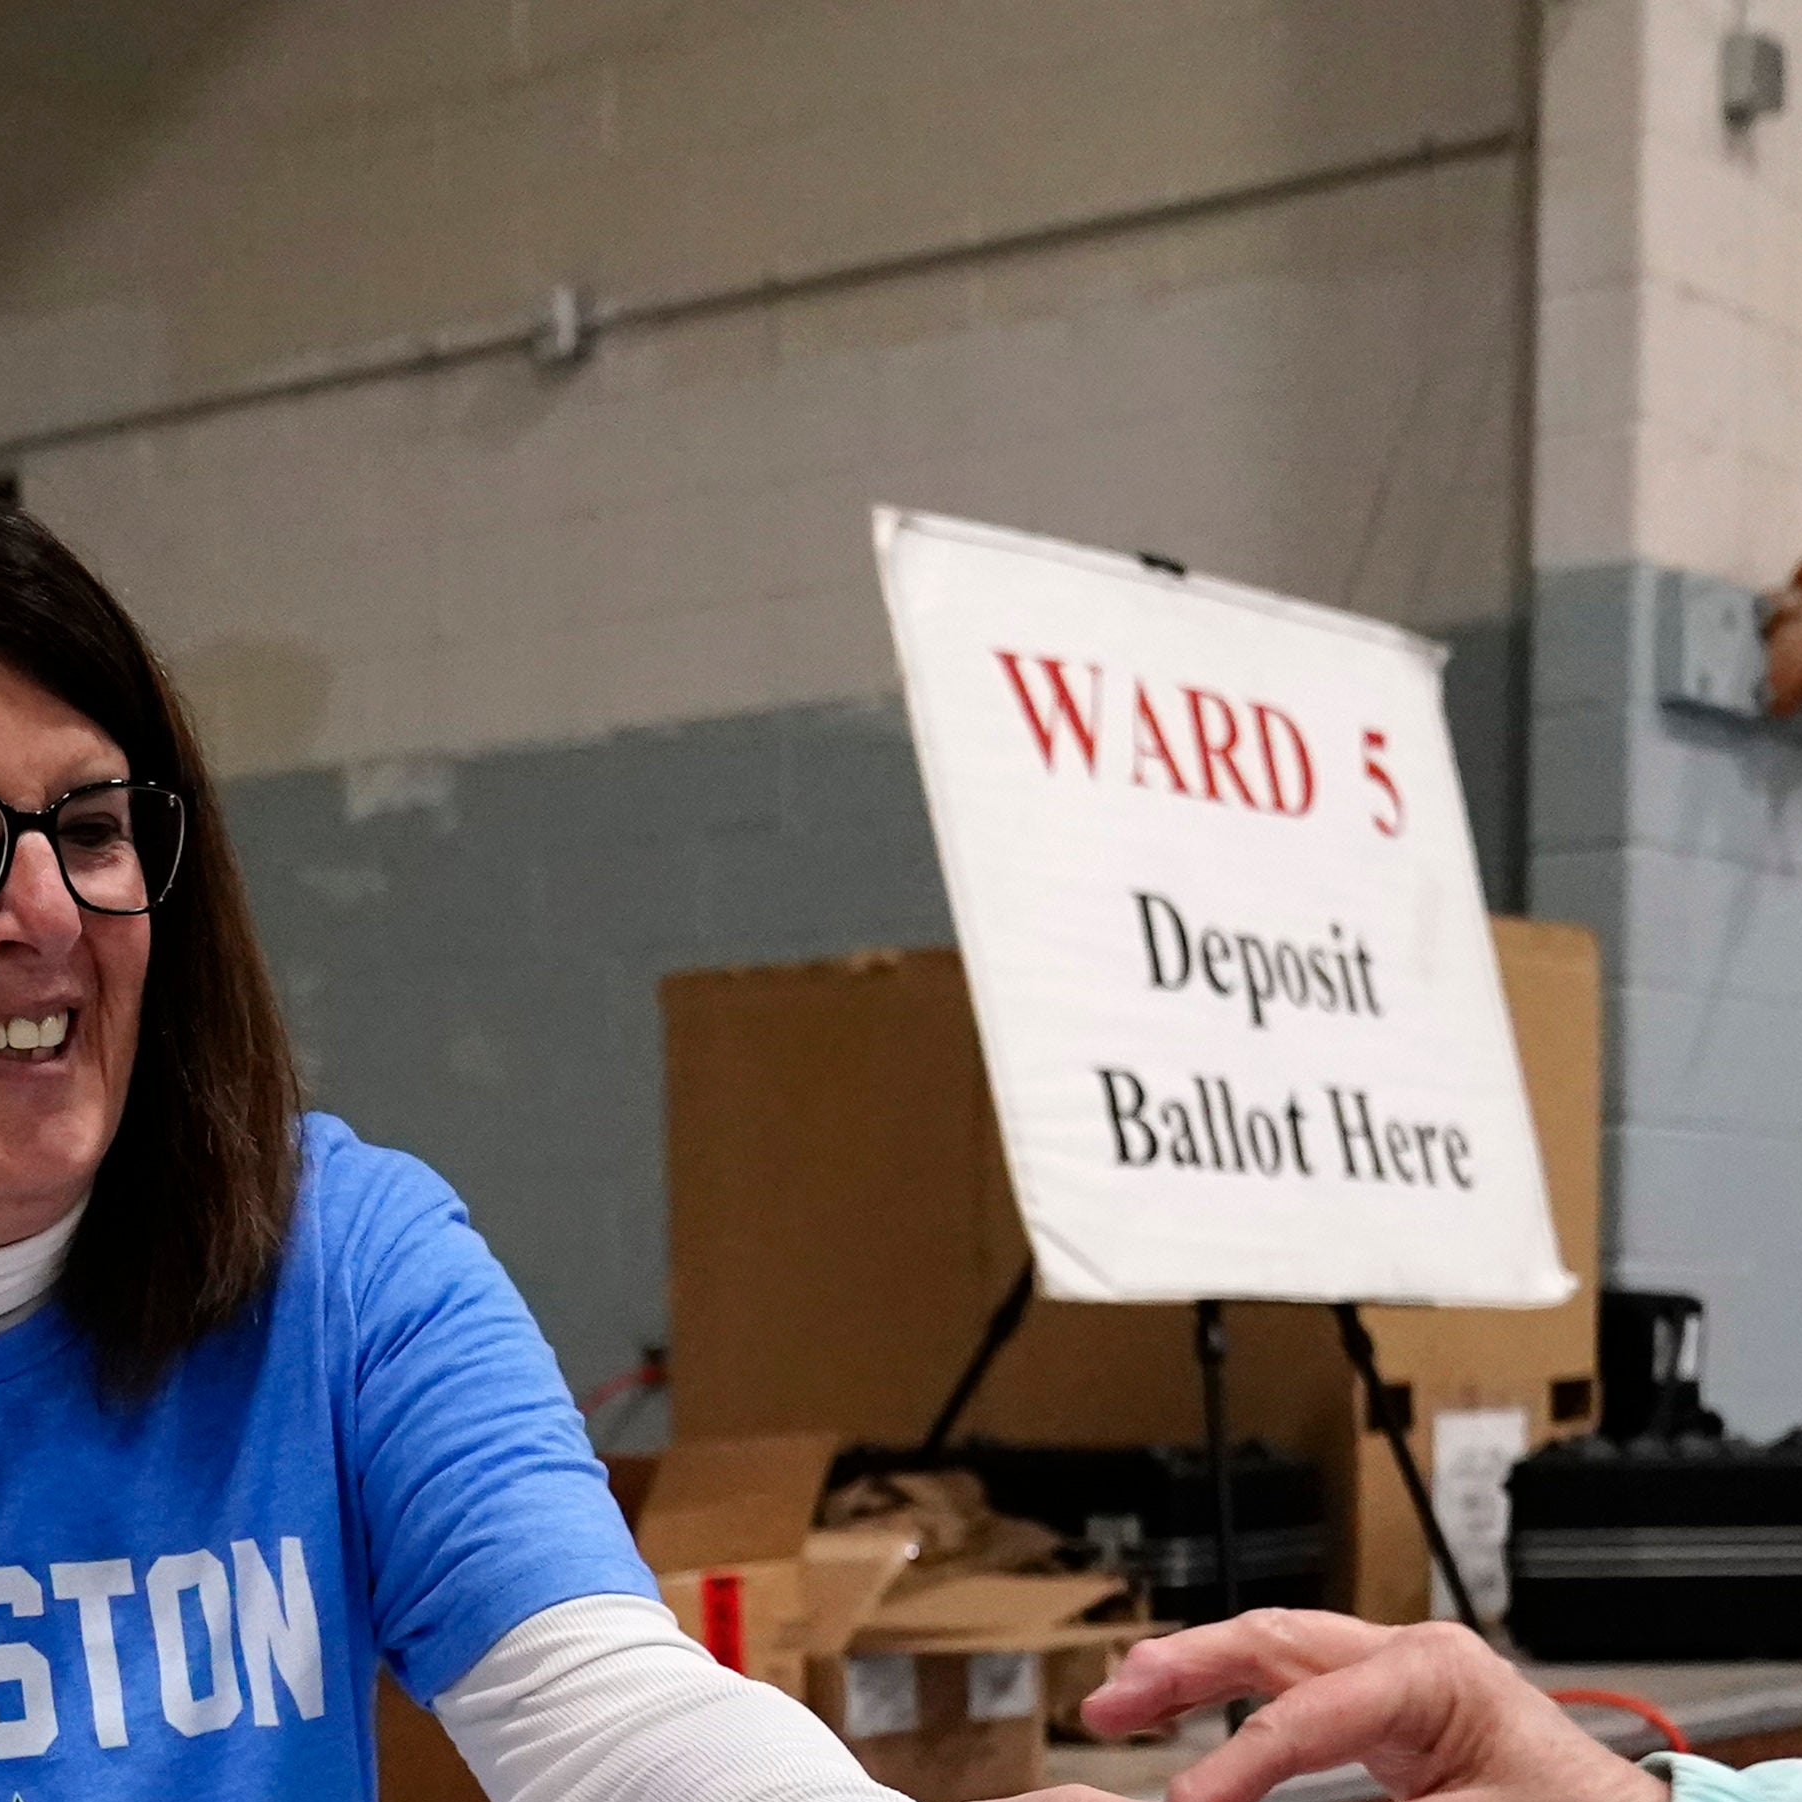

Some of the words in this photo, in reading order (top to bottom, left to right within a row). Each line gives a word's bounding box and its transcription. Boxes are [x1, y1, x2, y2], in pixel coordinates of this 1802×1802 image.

[995, 647, 1317, 819] WARD
[1361, 725, 1405, 838] 5
[1131, 887, 1384, 1030] Deposit
[1097, 1064, 1315, 1178] Ballot
[1324, 1083, 1475, 1192] Here
